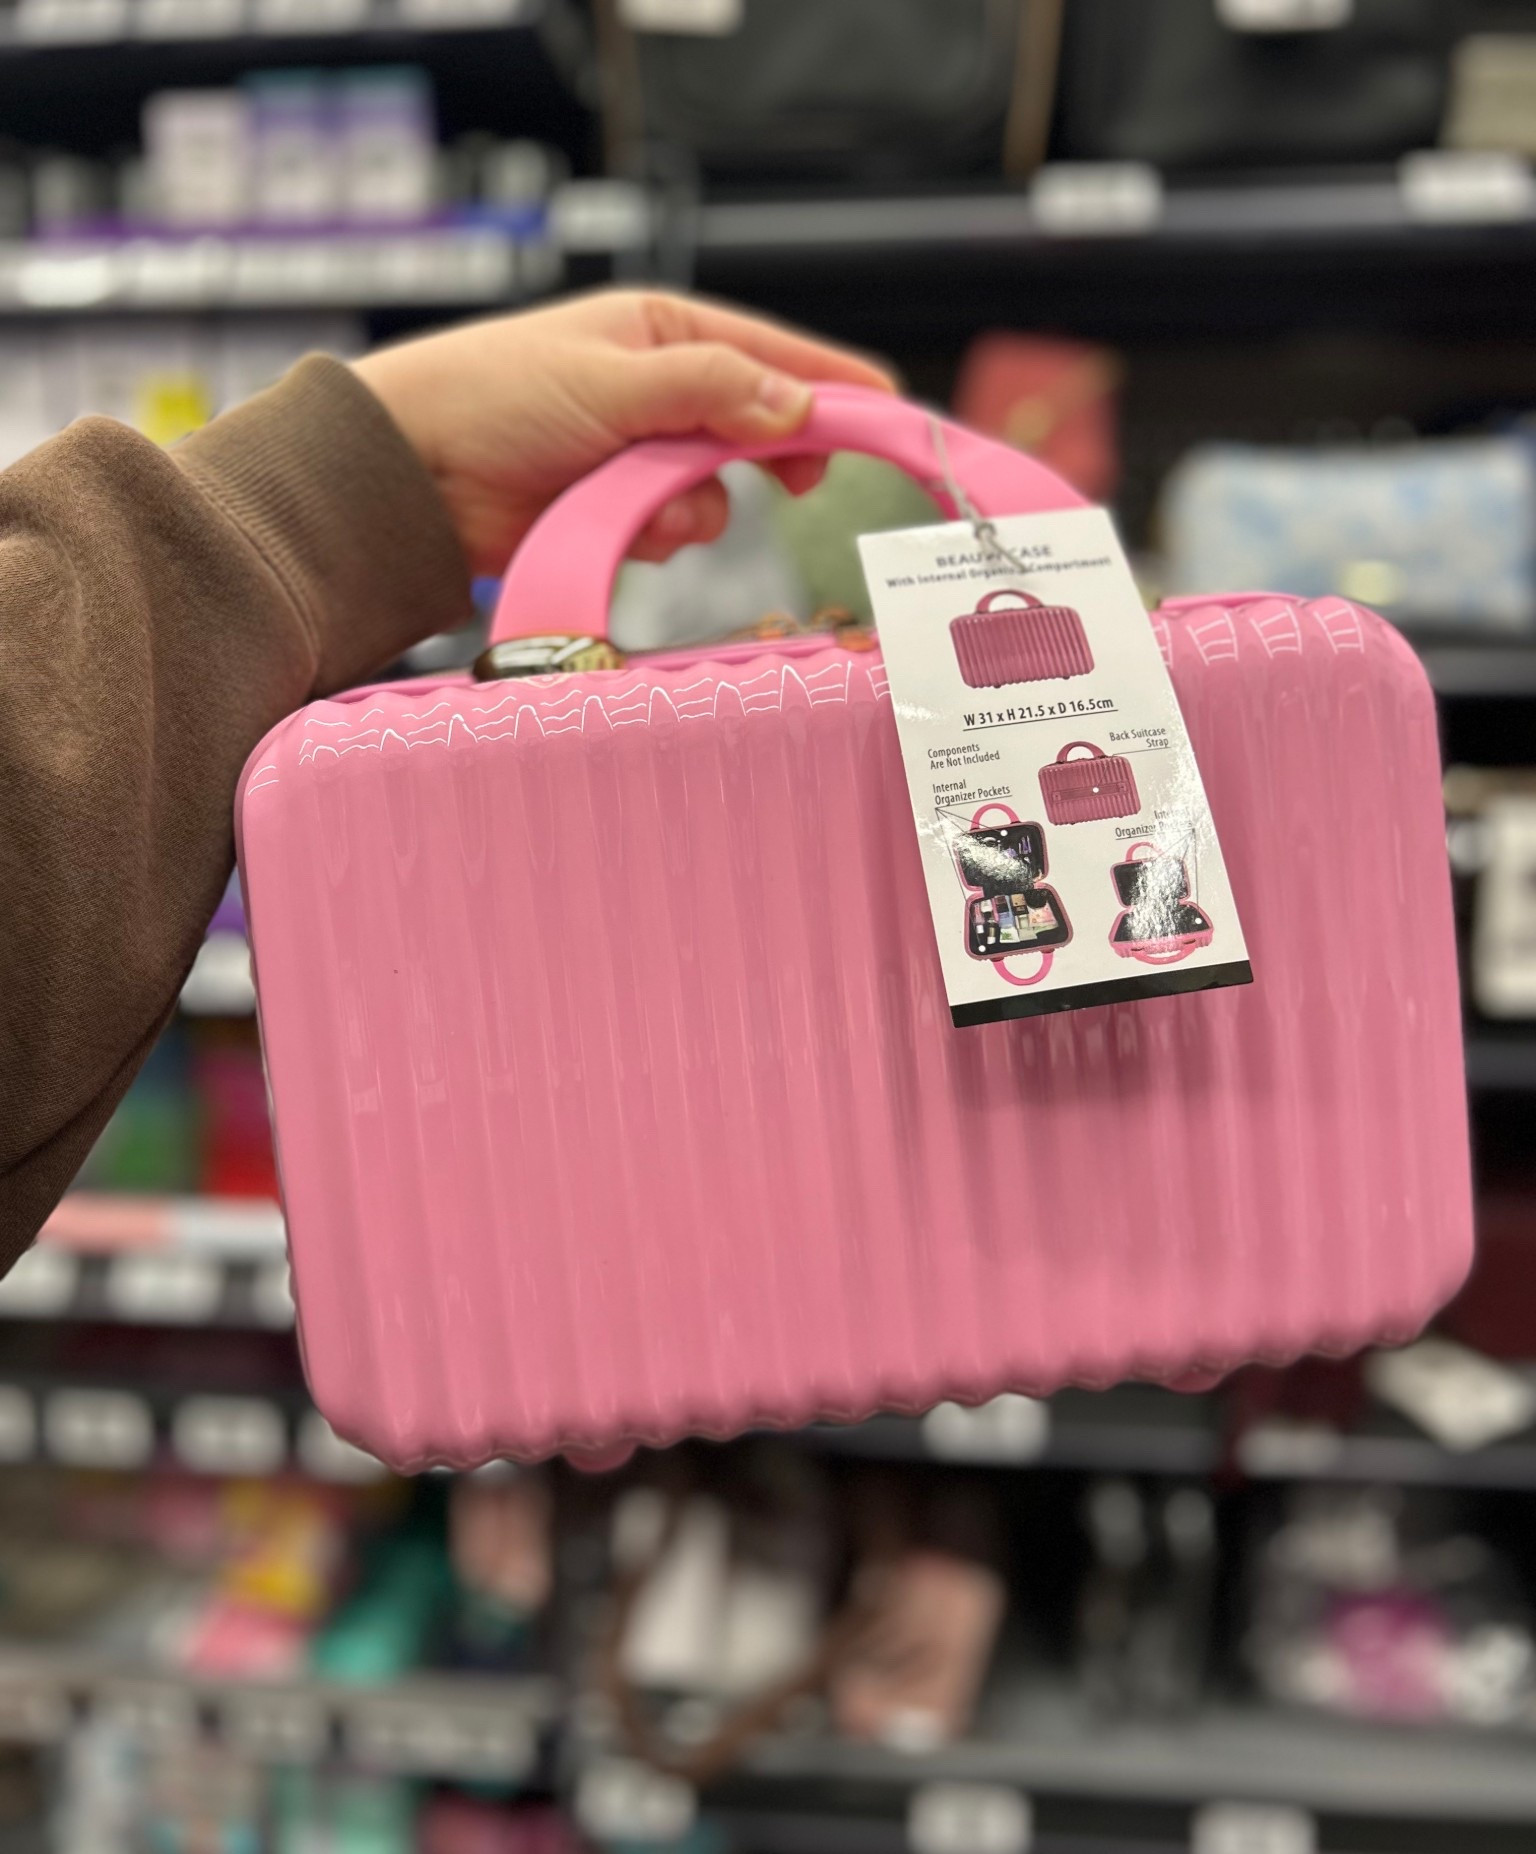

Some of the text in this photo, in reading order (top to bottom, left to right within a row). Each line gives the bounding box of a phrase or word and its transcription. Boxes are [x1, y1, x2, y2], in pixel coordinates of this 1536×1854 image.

[885, 575, 915, 588] With
[963, 698, 1114, 726] W 31 x H 21.5 x D 16.5cm
[1109, 728, 1166, 741] Back Suitcase
[927, 743, 981, 759] Components
[1146, 738, 1169, 749] Strap
[930, 750, 1000, 770] Are Not Included
[932, 778, 967, 793] Internal
[935, 785, 1011, 808] Organizer Pockets
